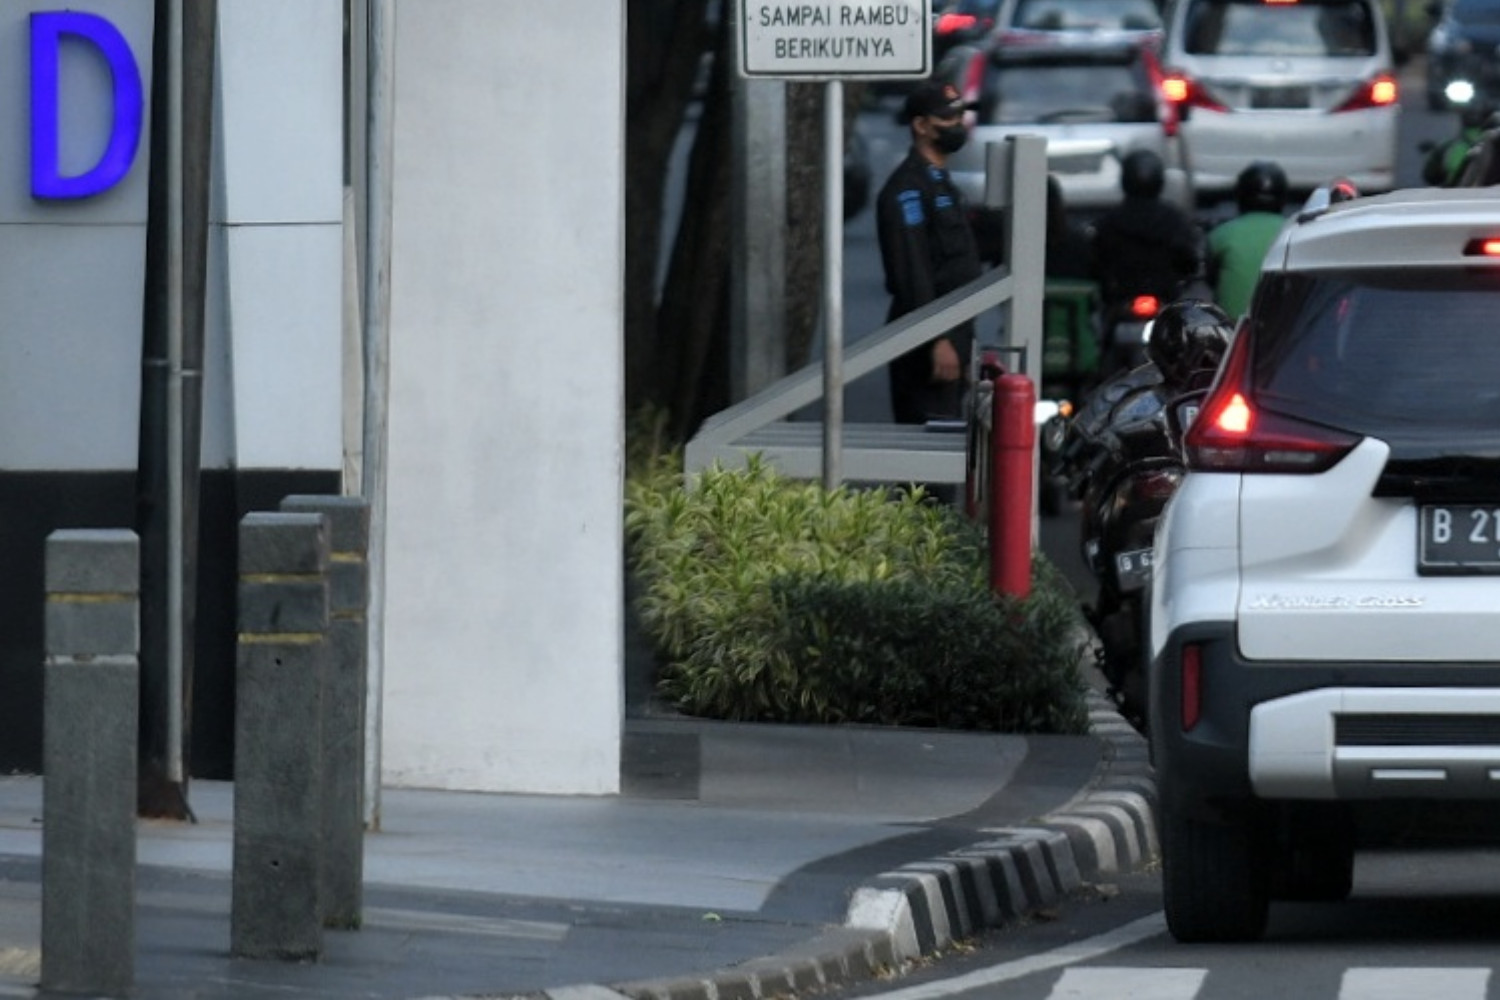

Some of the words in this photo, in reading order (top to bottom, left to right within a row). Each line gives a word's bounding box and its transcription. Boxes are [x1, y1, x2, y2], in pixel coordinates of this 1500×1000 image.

[760, 5, 830, 27] SAMPAI
[840, 5, 909, 26] RAMBU
[775, 37, 895, 59] BERIKUTNYA
[1433, 508, 1451, 543] B
